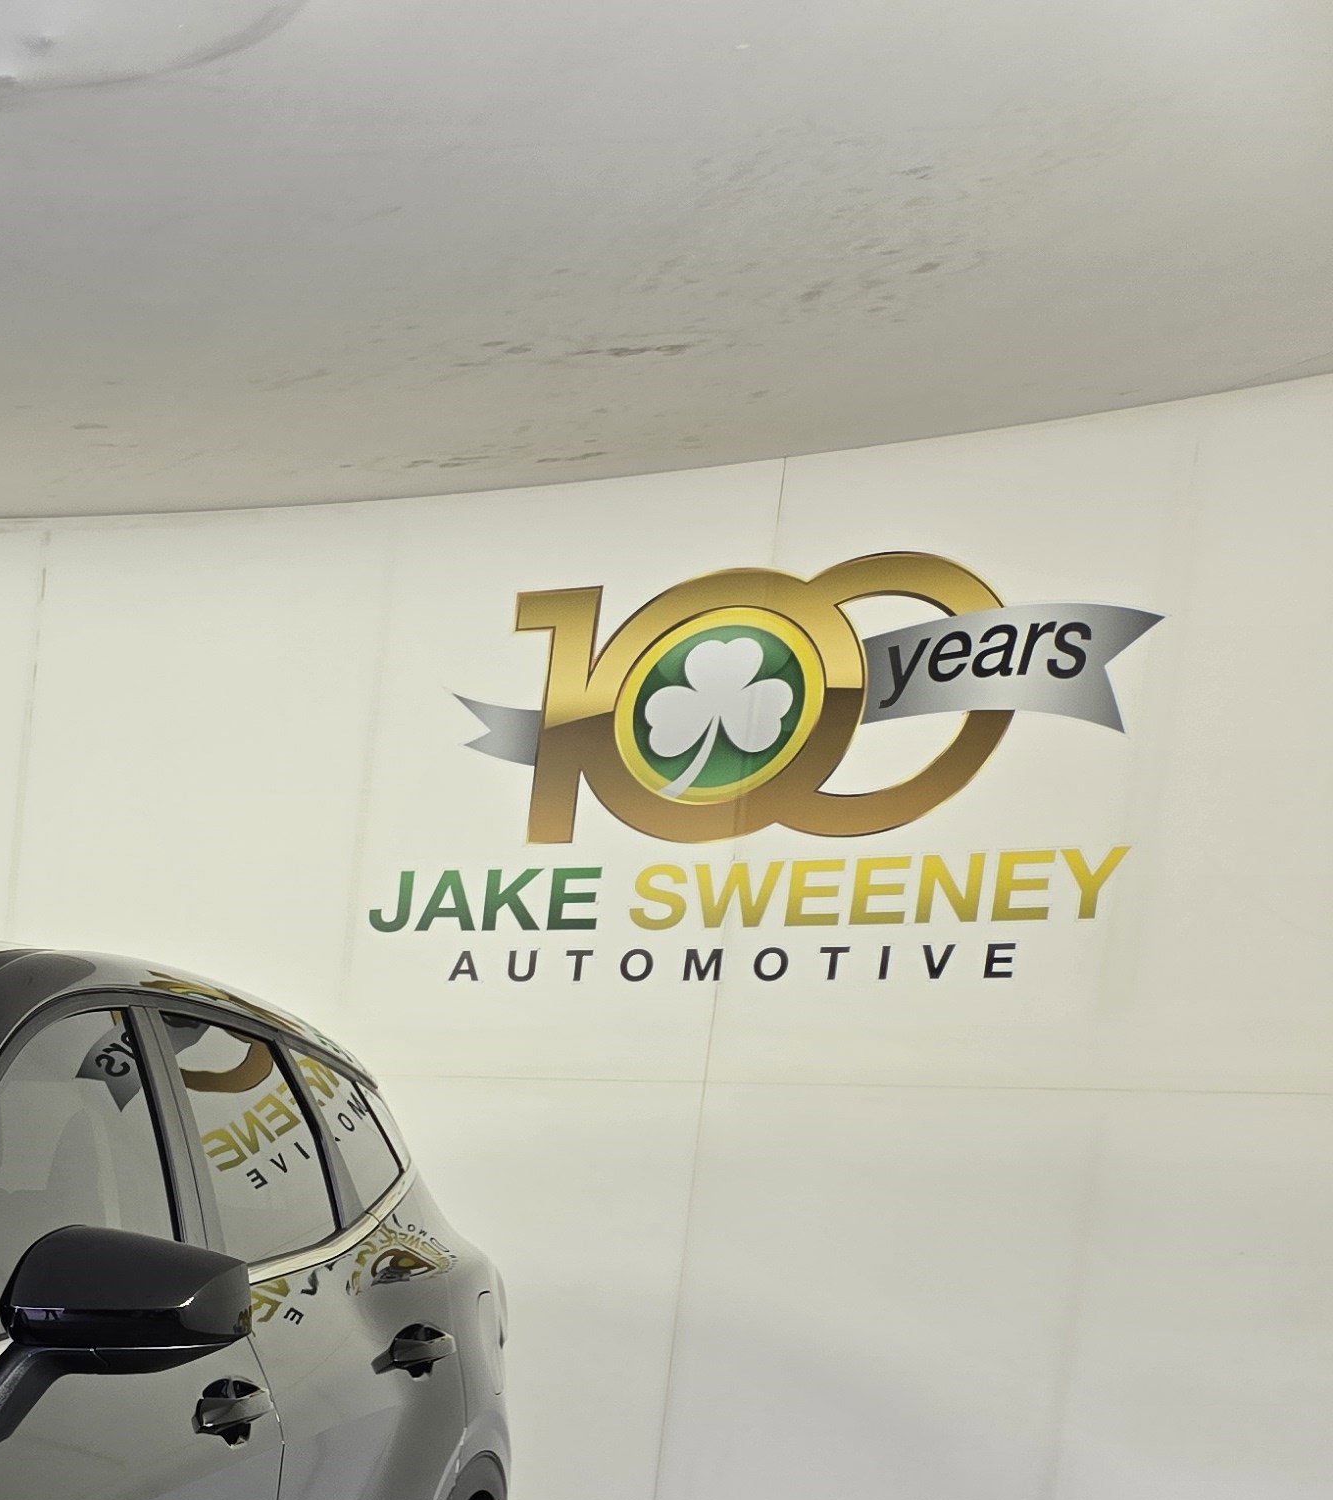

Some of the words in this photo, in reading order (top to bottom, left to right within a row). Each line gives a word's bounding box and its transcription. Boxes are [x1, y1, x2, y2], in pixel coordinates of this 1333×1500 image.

[515, 550, 1017, 845] 100
[879, 619, 1092, 711] years
[368, 866, 603, 933] JAKE
[629, 845, 1132, 931] SWEENEY
[448, 942, 1018, 983] AUTOMOTIVE
